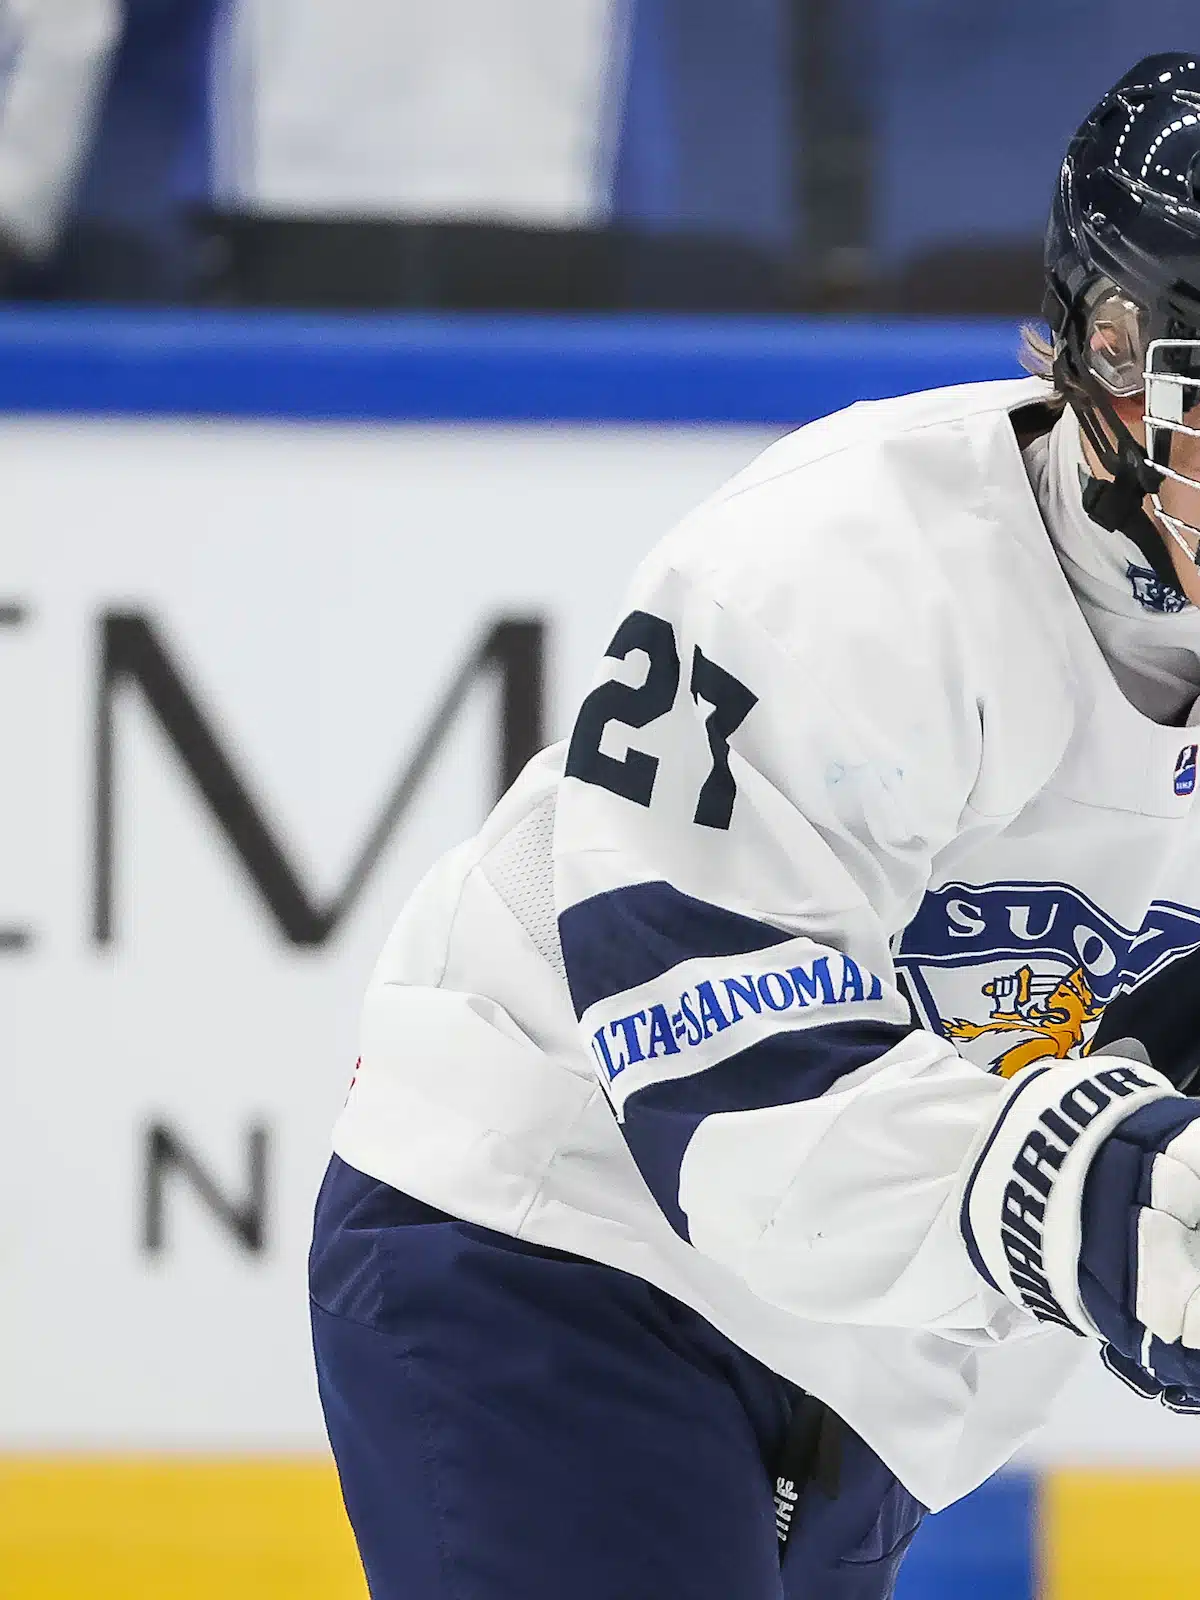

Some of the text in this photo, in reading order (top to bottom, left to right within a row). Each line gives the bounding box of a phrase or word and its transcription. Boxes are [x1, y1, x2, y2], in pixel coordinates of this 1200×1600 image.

[564, 609, 760, 831] 27
[945, 899, 1164, 977] SUO
[1000, 1066, 1160, 1338] WARRIOR
